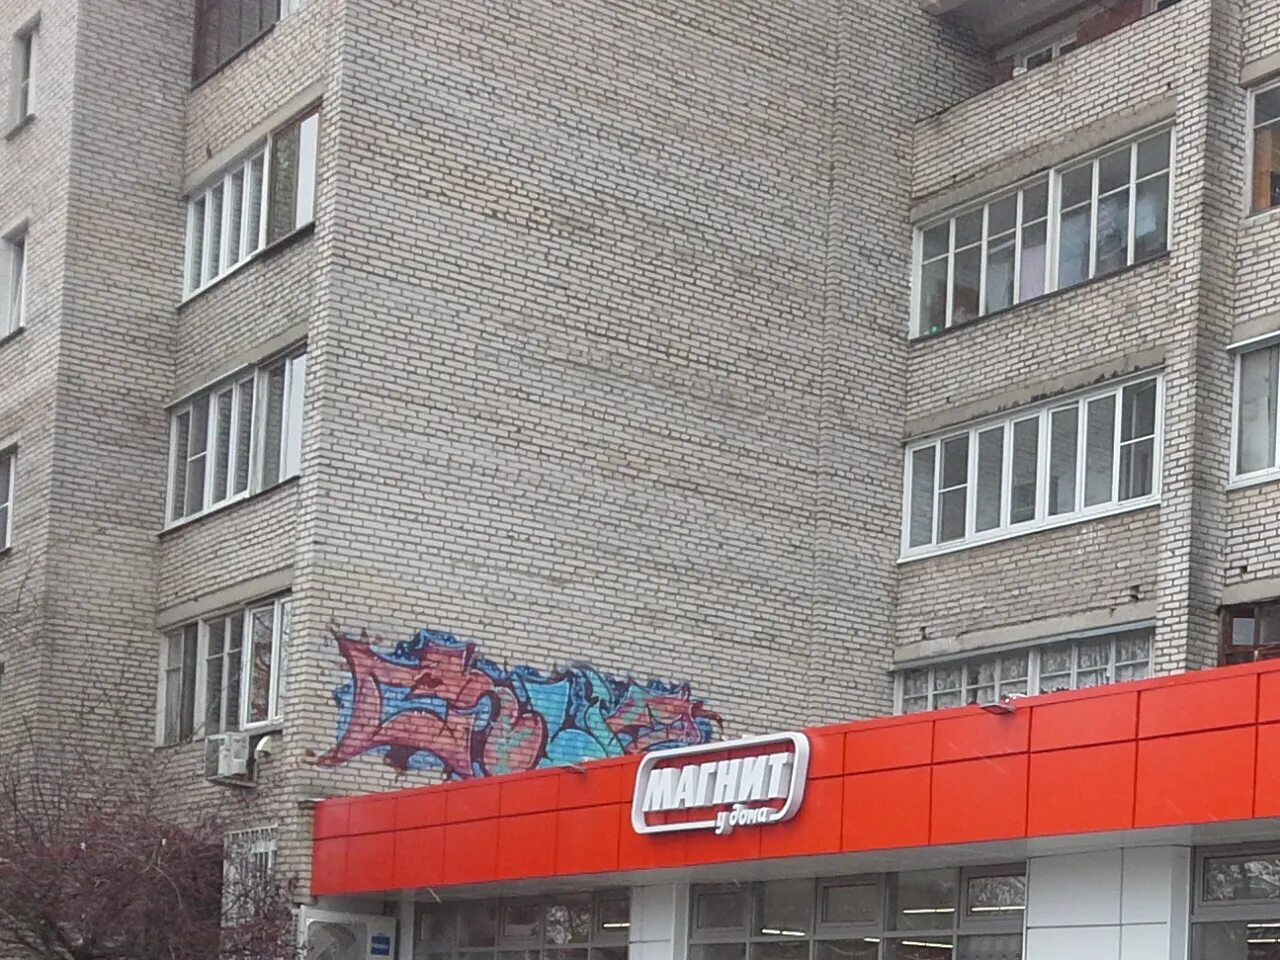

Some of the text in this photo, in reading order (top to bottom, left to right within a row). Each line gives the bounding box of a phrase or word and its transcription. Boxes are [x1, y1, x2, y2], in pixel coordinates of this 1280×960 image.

[642, 752, 792, 812] МАГНИТ
[715, 804, 769, 835] у дома
